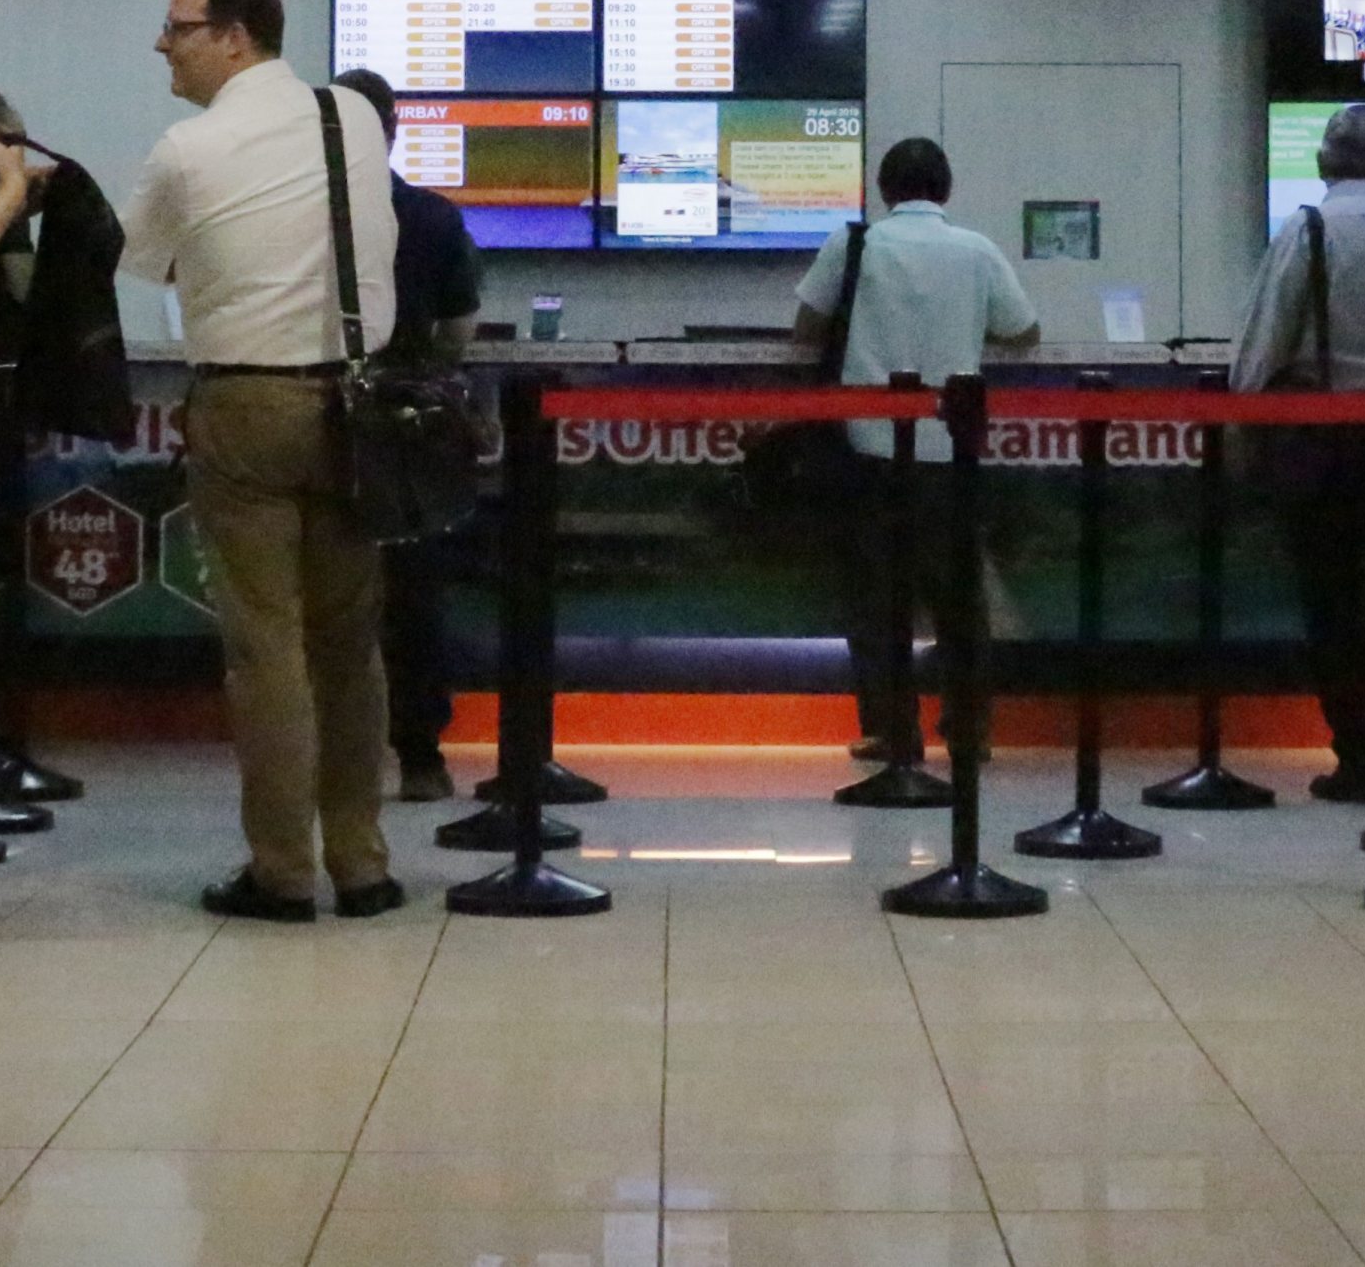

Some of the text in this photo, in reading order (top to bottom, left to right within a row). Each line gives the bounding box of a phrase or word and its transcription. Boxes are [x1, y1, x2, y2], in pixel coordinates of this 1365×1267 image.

[340, 4, 367, 12] 09:30
[340, 19, 367, 27] 10:50
[340, 33, 367, 41] 12:30
[340, 48, 367, 56] 14:20
[543, 108, 589, 121] 09:10
[805, 118, 860, 136] 08:30
[47, 509, 116, 536] Hotel
[54, 550, 107, 585] 48
